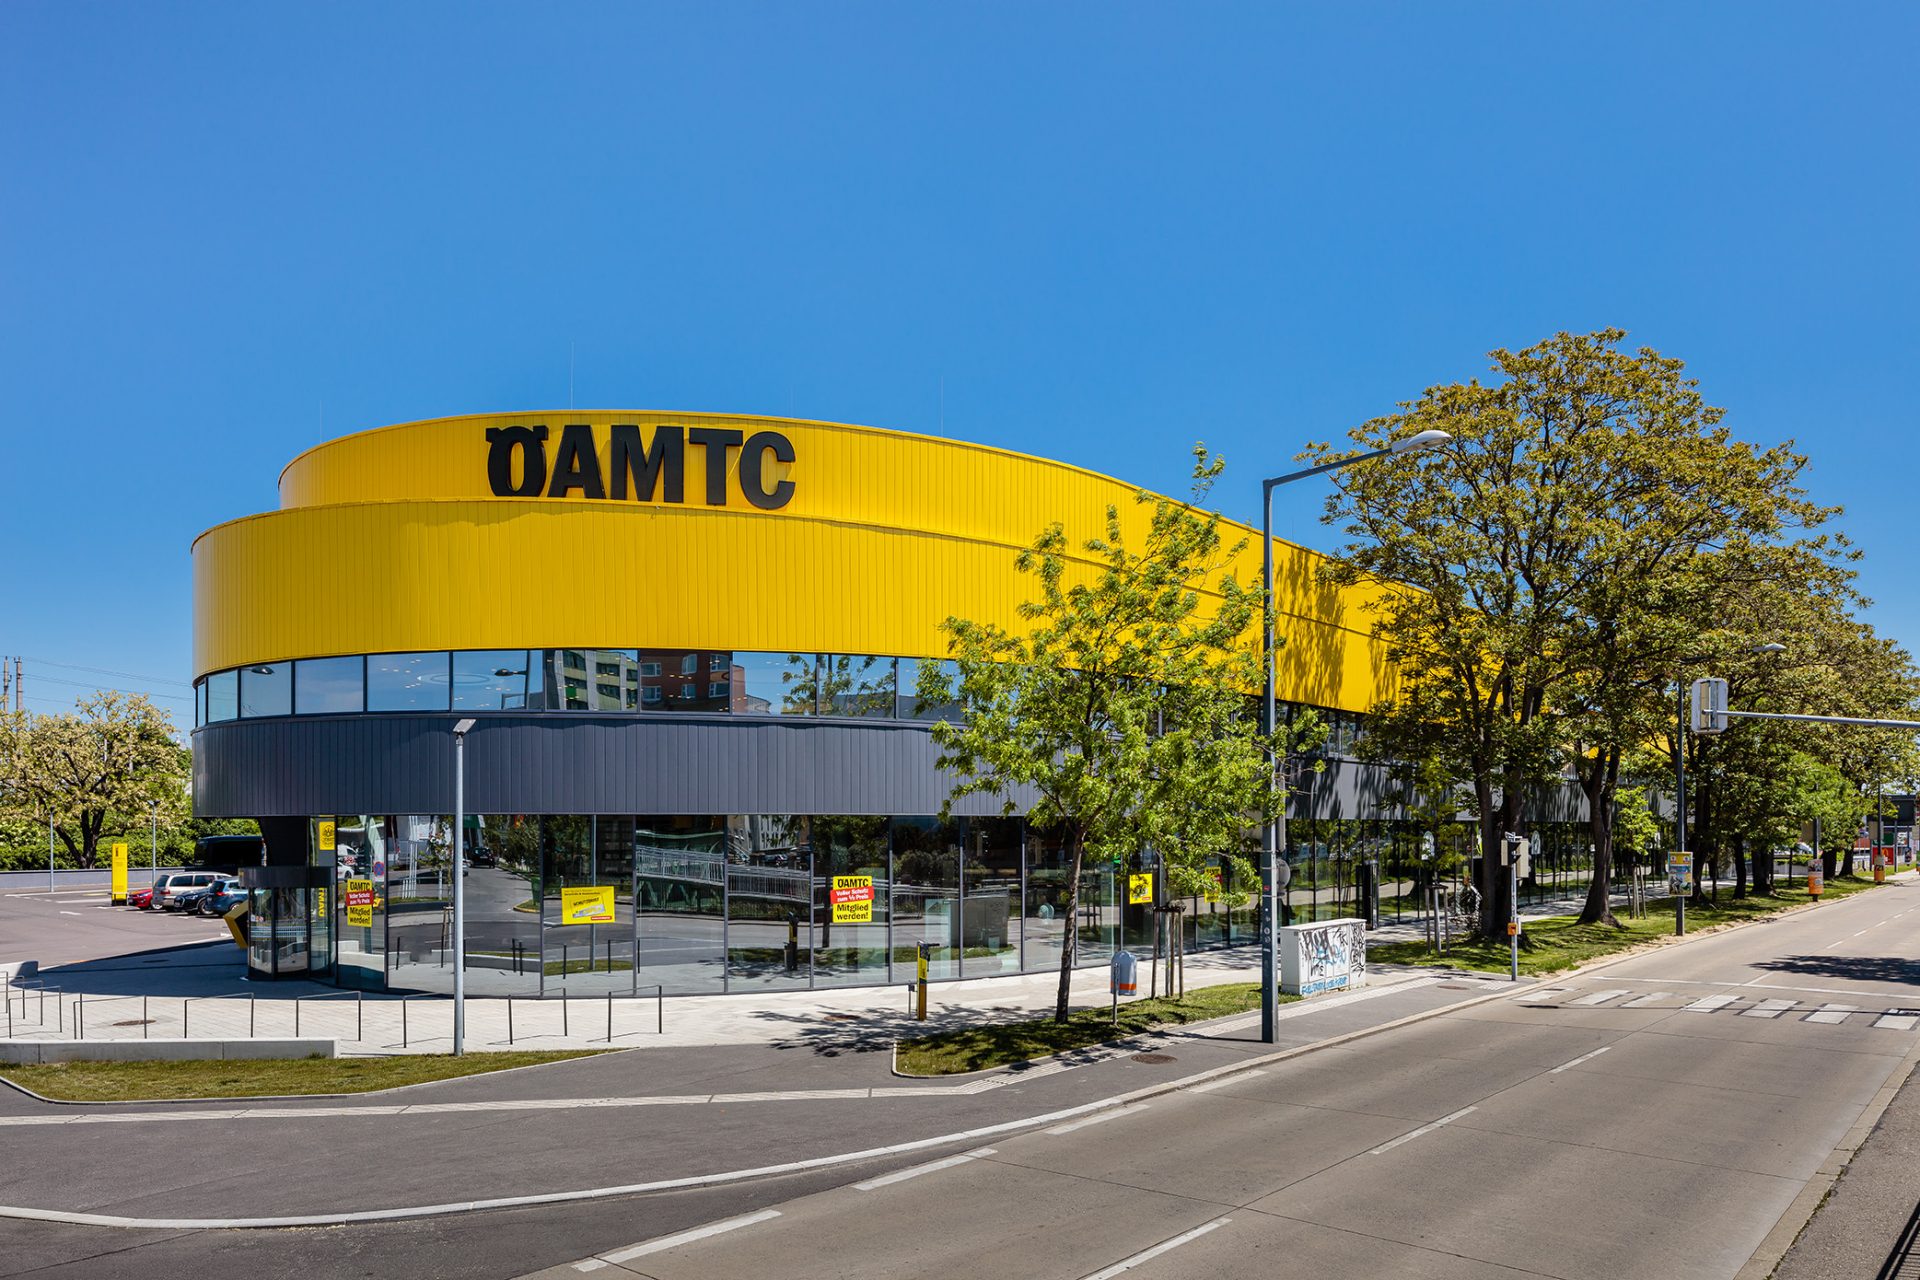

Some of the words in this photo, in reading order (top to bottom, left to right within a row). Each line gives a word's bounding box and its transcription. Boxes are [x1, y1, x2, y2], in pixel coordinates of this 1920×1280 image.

[485, 424, 796, 510] ÖAMTC
[350, 882, 370, 891] ÖAMTC
[837, 879, 869, 888] ÖAMTC
[837, 904, 869, 913] Mitglied
[837, 912, 868, 920] werden!
